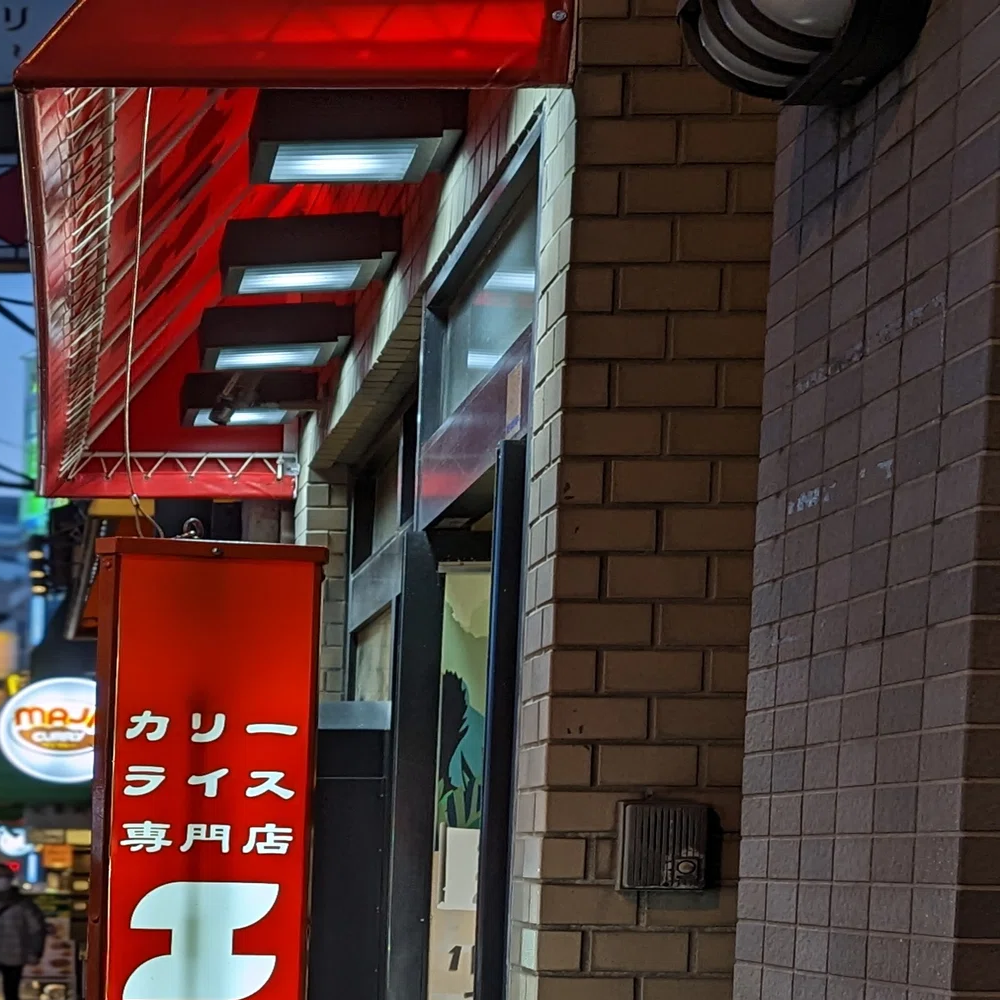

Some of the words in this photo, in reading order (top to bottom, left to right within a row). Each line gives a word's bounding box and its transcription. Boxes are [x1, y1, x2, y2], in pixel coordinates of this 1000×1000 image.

[125, 710, 299, 743] カリー
[123, 765, 296, 800] ライス
[119, 820, 295, 855] 専門店
